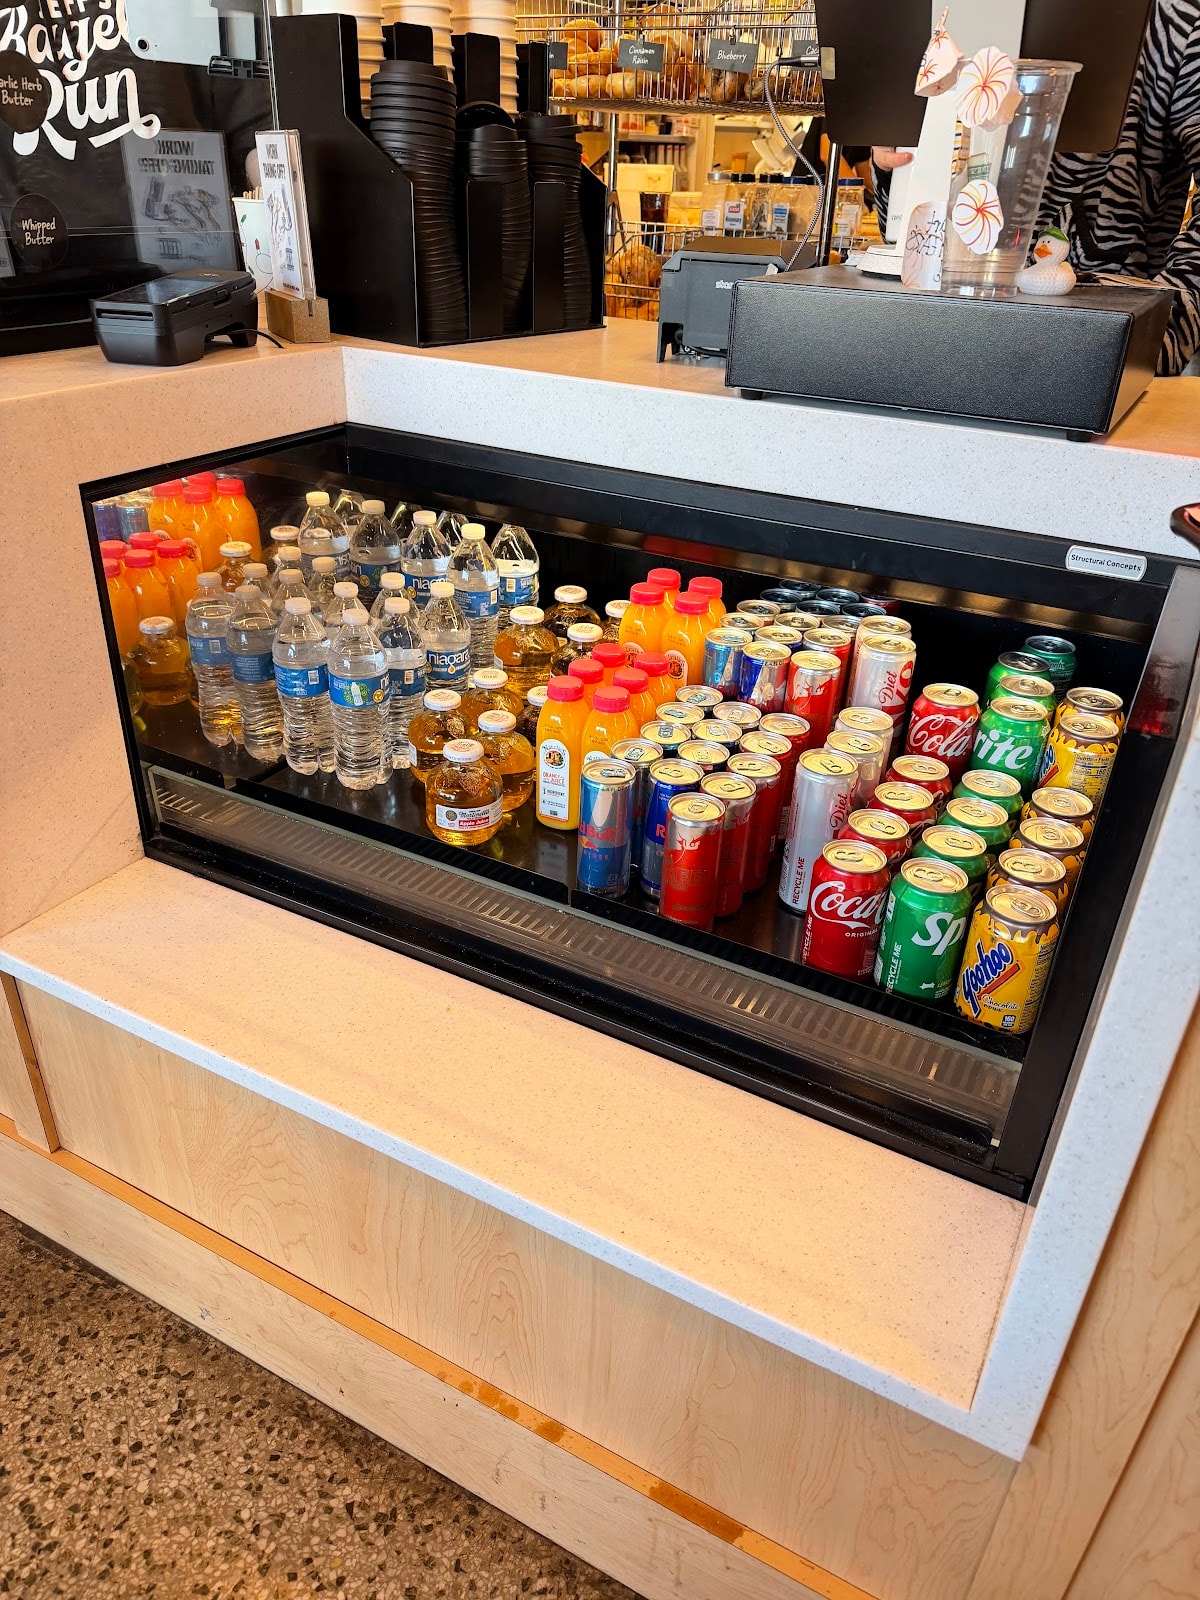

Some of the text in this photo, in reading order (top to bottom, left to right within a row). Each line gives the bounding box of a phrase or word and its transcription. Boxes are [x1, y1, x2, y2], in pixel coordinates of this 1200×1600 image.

[628, 45, 656, 55] Cinnamon
[717, 49, 748, 63] Blueberry
[632, 55, 650, 65] Raisin
[0, 74, 43, 92] arlic Herb
[1, 89, 34, 107] Butter
[13, 68, 162, 160] Run
[265, 143, 279, 160] WORK
[21, 217, 57, 240] Whipped
[24, 231, 55, 246] Butter
[1071, 554, 1142, 572] Structural Concepts
[429, 651, 470, 667] niagara
[878, 670, 898, 704] Diet
[974, 728, 1033, 771] rite
[830, 793, 848, 829] Diet
[792, 856, 805, 905] RECYCLE ME
[886, 941, 903, 994] RECYCLE ME
[981, 993, 1020, 1011] Chocolate
